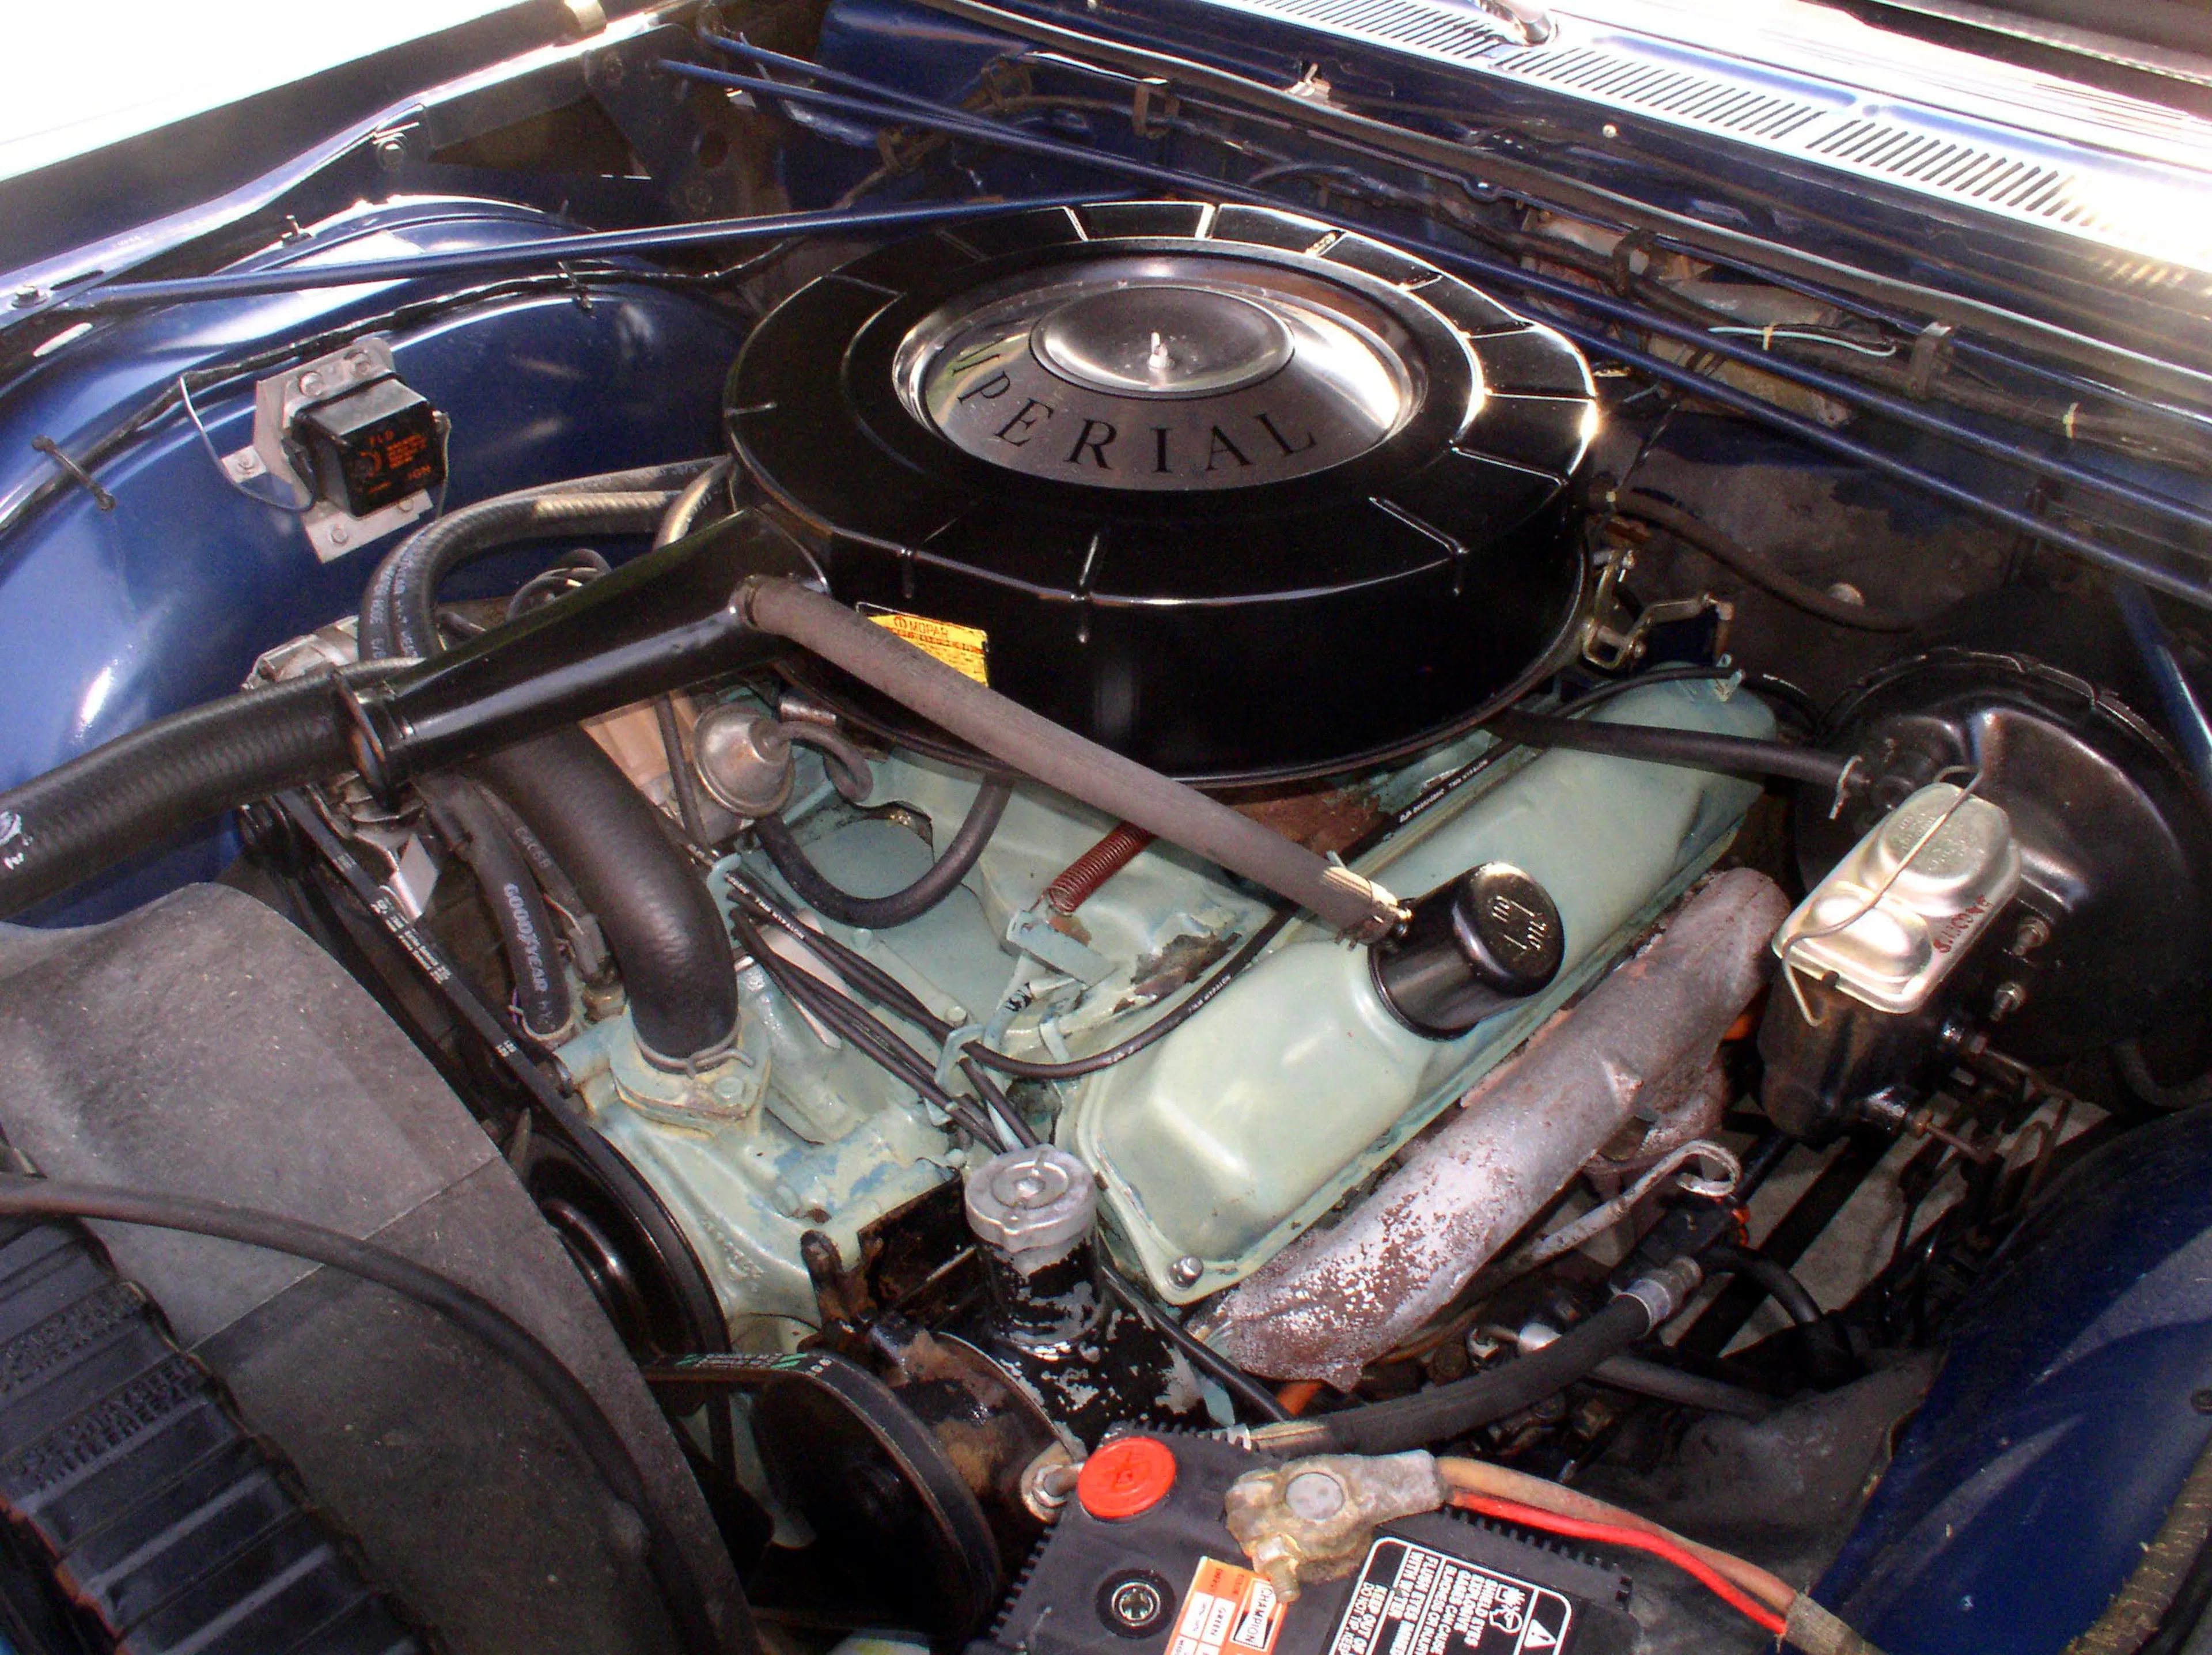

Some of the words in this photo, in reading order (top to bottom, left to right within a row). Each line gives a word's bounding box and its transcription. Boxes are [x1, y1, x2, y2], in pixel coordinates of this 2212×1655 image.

[952, 334, 1317, 474] MPERIAL
[503, 883, 548, 992] GOODYEAR
[1402, 1551, 1425, 1581] WITH
[1415, 1555, 1440, 1593] FLUSH
[1360, 1581, 1375, 1598] DO
[1368, 1584, 1389, 1616] KEEP
[1388, 1579, 1415, 1620] WATER
[1430, 1565, 1457, 1614] BLINDNESS
[1449, 1570, 1472, 1607] GASES
[1454, 1574, 1485, 1633] EXPLOSIVE
[1475, 1579, 1498, 1618] SHIELD
[1210, 1605, 1226, 1637] GREEN
[1245, 1586, 1273, 1642] CHAMPION
[1354, 1596, 1369, 1616] NOT
[1404, 1590, 1427, 1622] EYES
[1425, 1611, 1440, 1628] OR
[1441, 1604, 1458, 1626] CAN
[1357, 1613, 1377, 1640] OUT
[1430, 1623, 1452, 1655] CAUSE
[1464, 1616, 1486, 1648] EYES
[1351, 1636, 1368, 1655] OF
